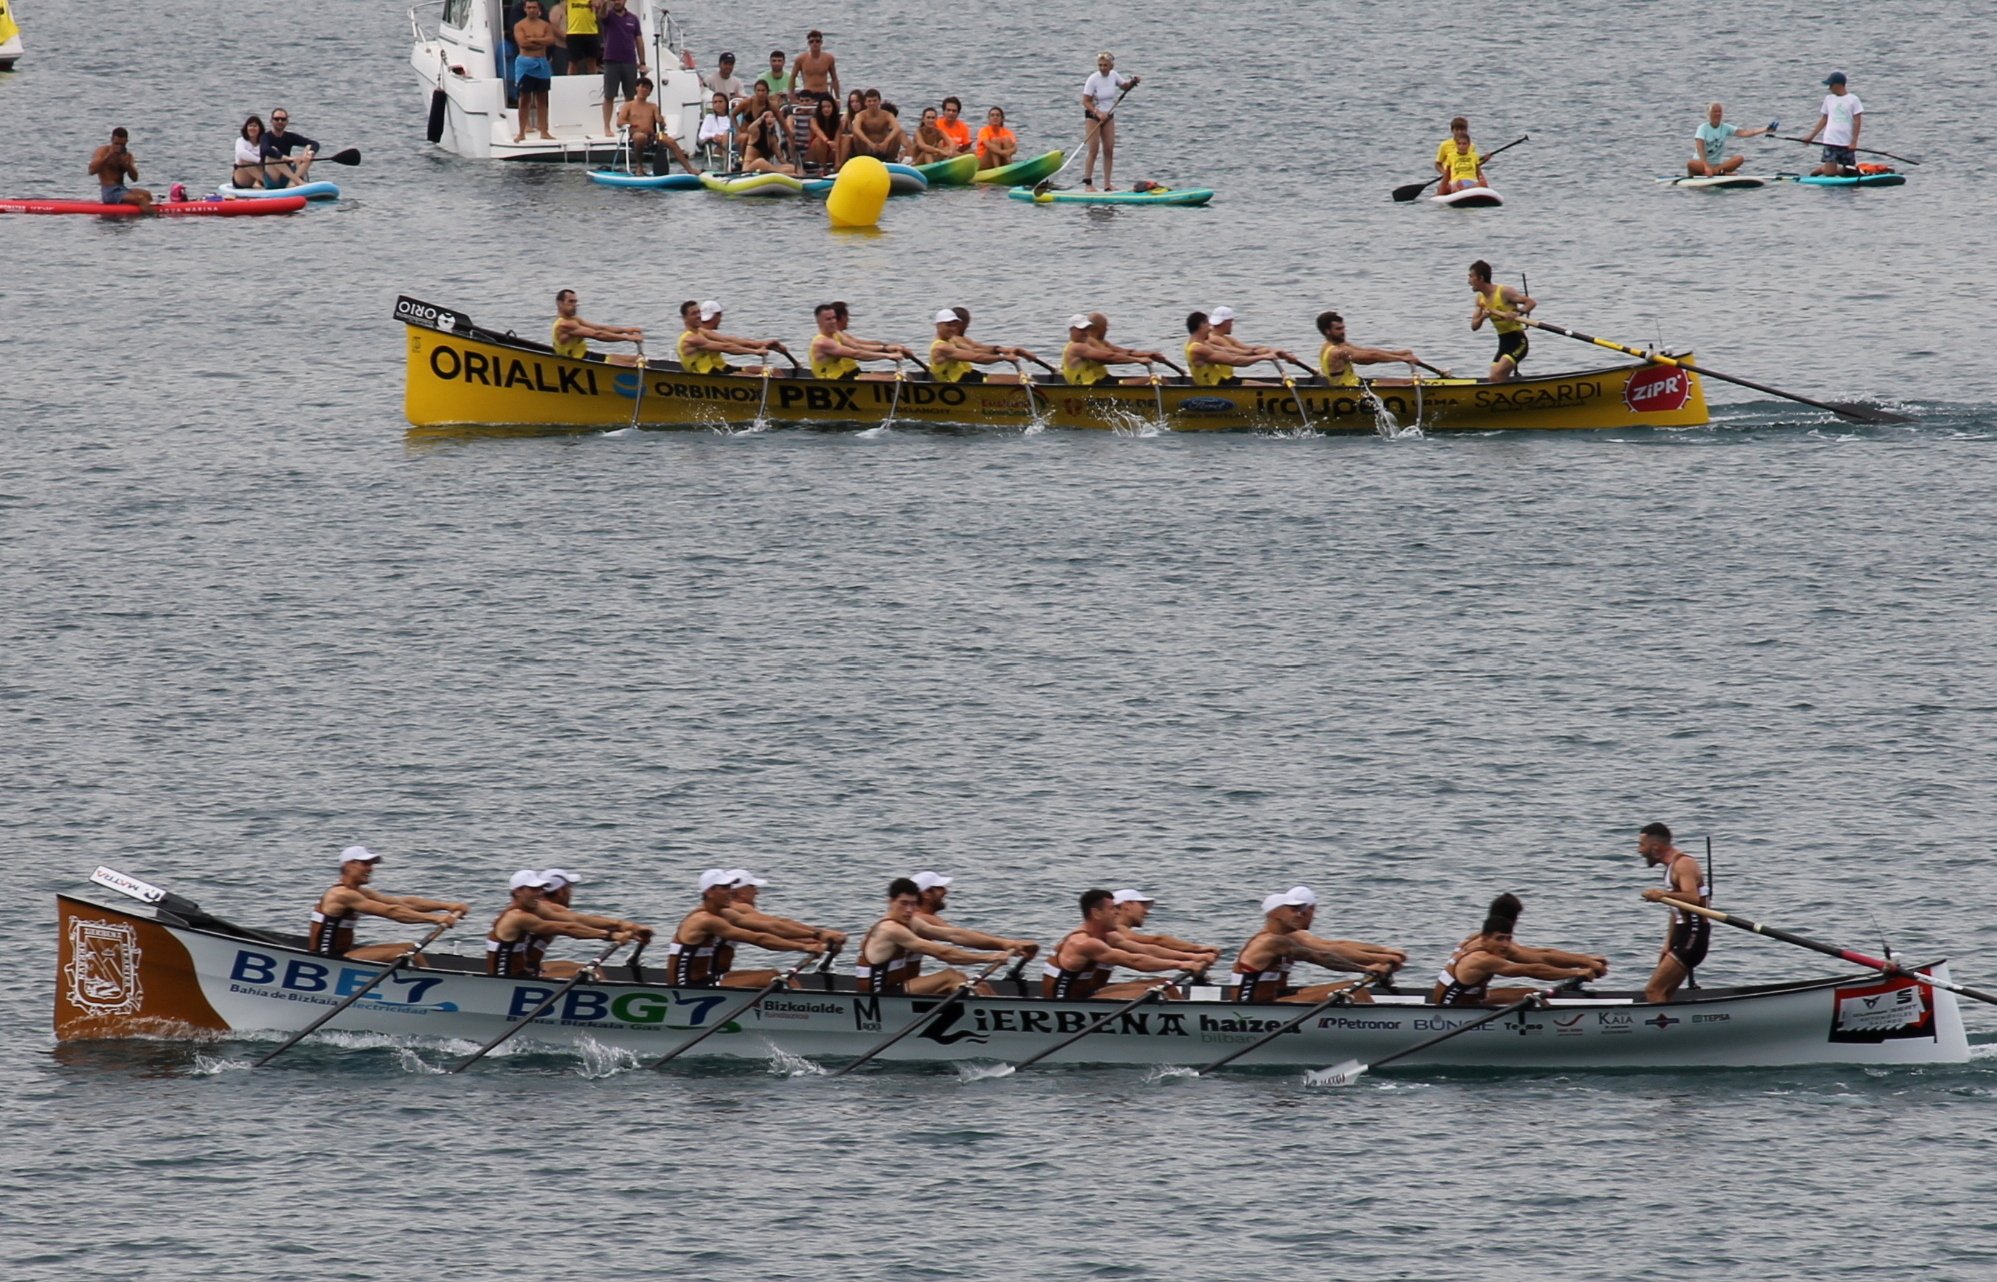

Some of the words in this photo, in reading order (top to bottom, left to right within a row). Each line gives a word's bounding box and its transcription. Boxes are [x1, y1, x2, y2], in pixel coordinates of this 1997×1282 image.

[398, 301, 437, 320] ORIO
[430, 345, 599, 396] ORIALKI
[654, 381, 765, 402] ORBINOX
[779, 385, 859, 412] PBX
[1475, 382, 1601, 409] SAGARDI
[270, 991, 288, 1000] de
[345, 1000, 428, 1016] lectricidad
[764, 1000, 844, 1014] Bizkaialde
[629, 1023, 662, 1031] Gas
[1199, 1013, 1302, 1034] haizea
[1338, 1017, 1402, 1030] Petronor
